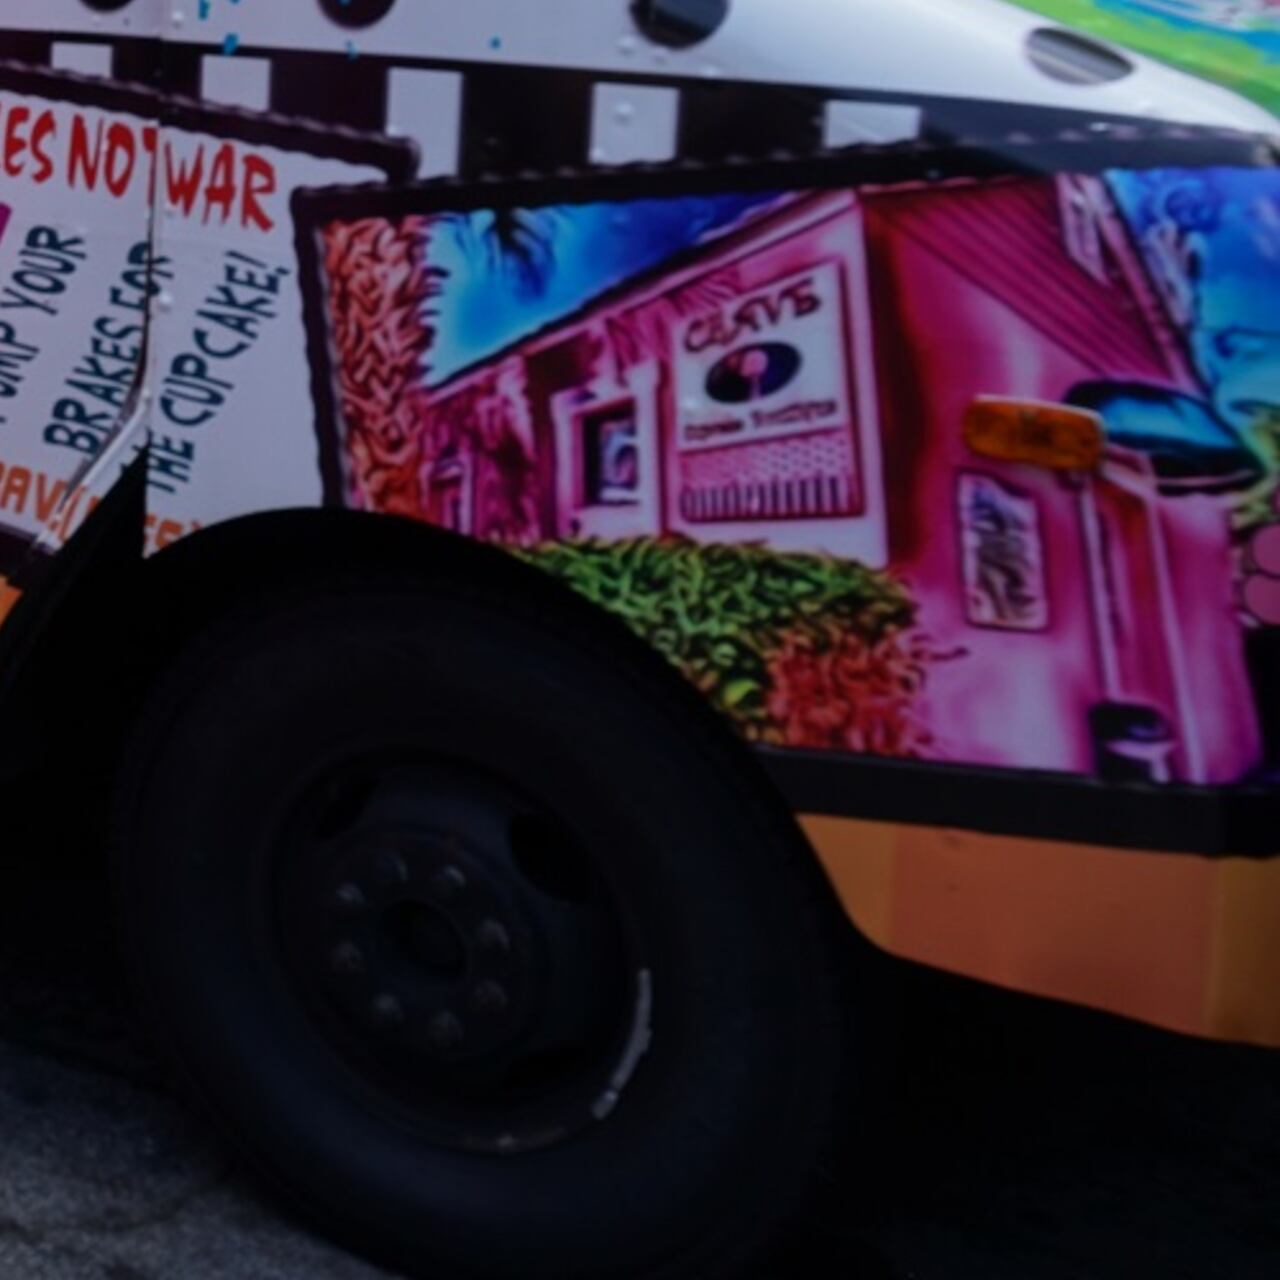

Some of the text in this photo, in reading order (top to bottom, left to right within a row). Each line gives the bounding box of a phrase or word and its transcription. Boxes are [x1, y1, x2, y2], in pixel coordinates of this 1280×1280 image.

[67, 114, 158, 209] NOT
[164, 140, 276, 233] WAR
[43, 241, 175, 456] BRAKES FOR
[159, 250, 291, 426] CUPCAKE!
